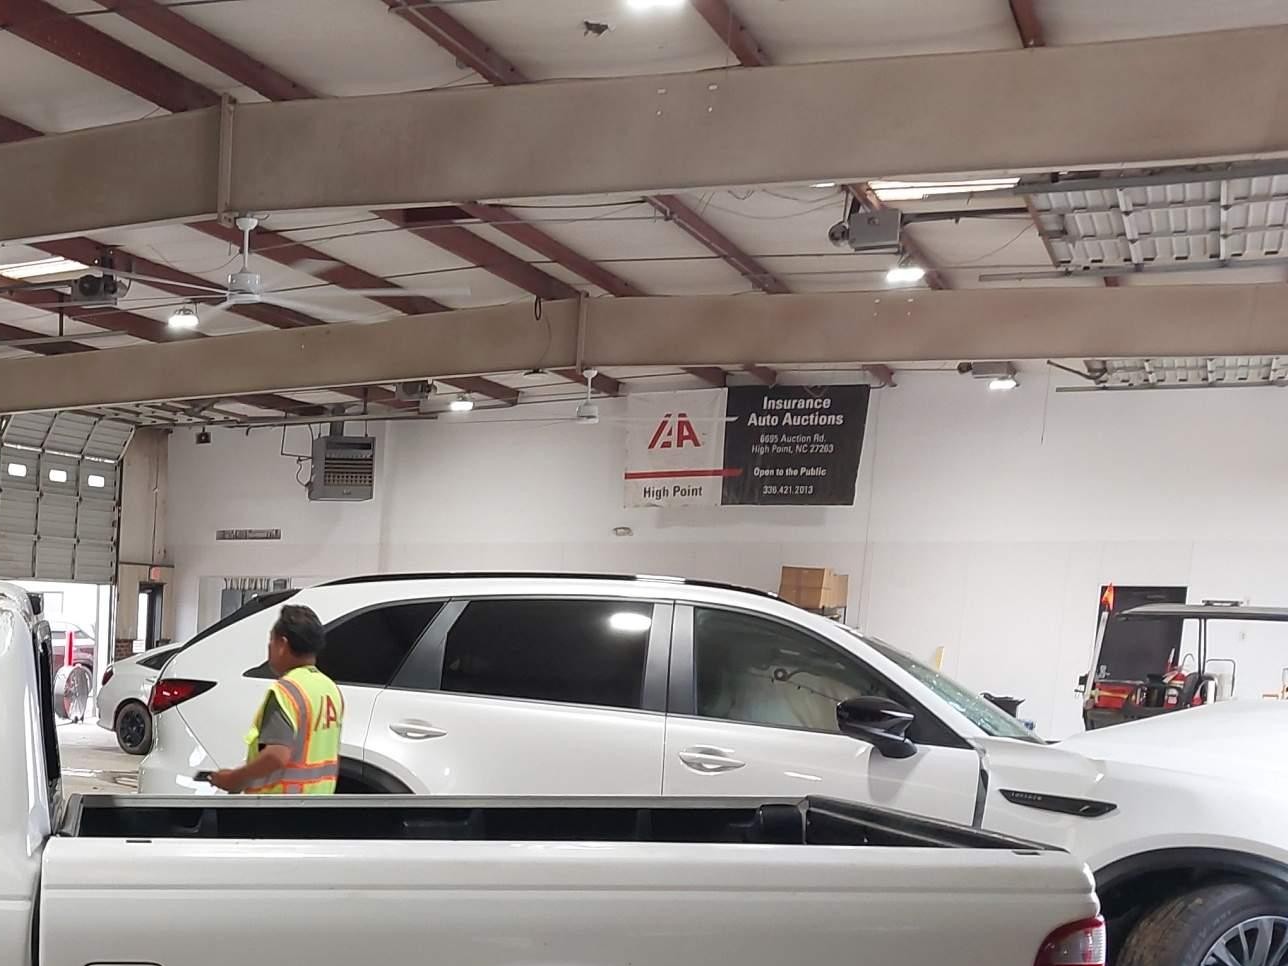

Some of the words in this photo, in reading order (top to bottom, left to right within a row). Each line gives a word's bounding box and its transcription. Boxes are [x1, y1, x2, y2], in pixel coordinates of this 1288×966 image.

[763, 396, 831, 411] Insurance
[747, 412, 779, 426] Auto
[782, 411, 844, 426] Auctions
[781, 433, 812, 443] Auction
[813, 434, 826, 443] Rd.
[752, 445, 769, 455] High
[796, 444, 808, 454] NC
[753, 467, 774, 478] Open
[776, 467, 784, 476] to
[785, 467, 798, 476] the
[800, 466, 827, 477] Public
[643, 486, 669, 500] High
[672, 485, 703, 498] Point
